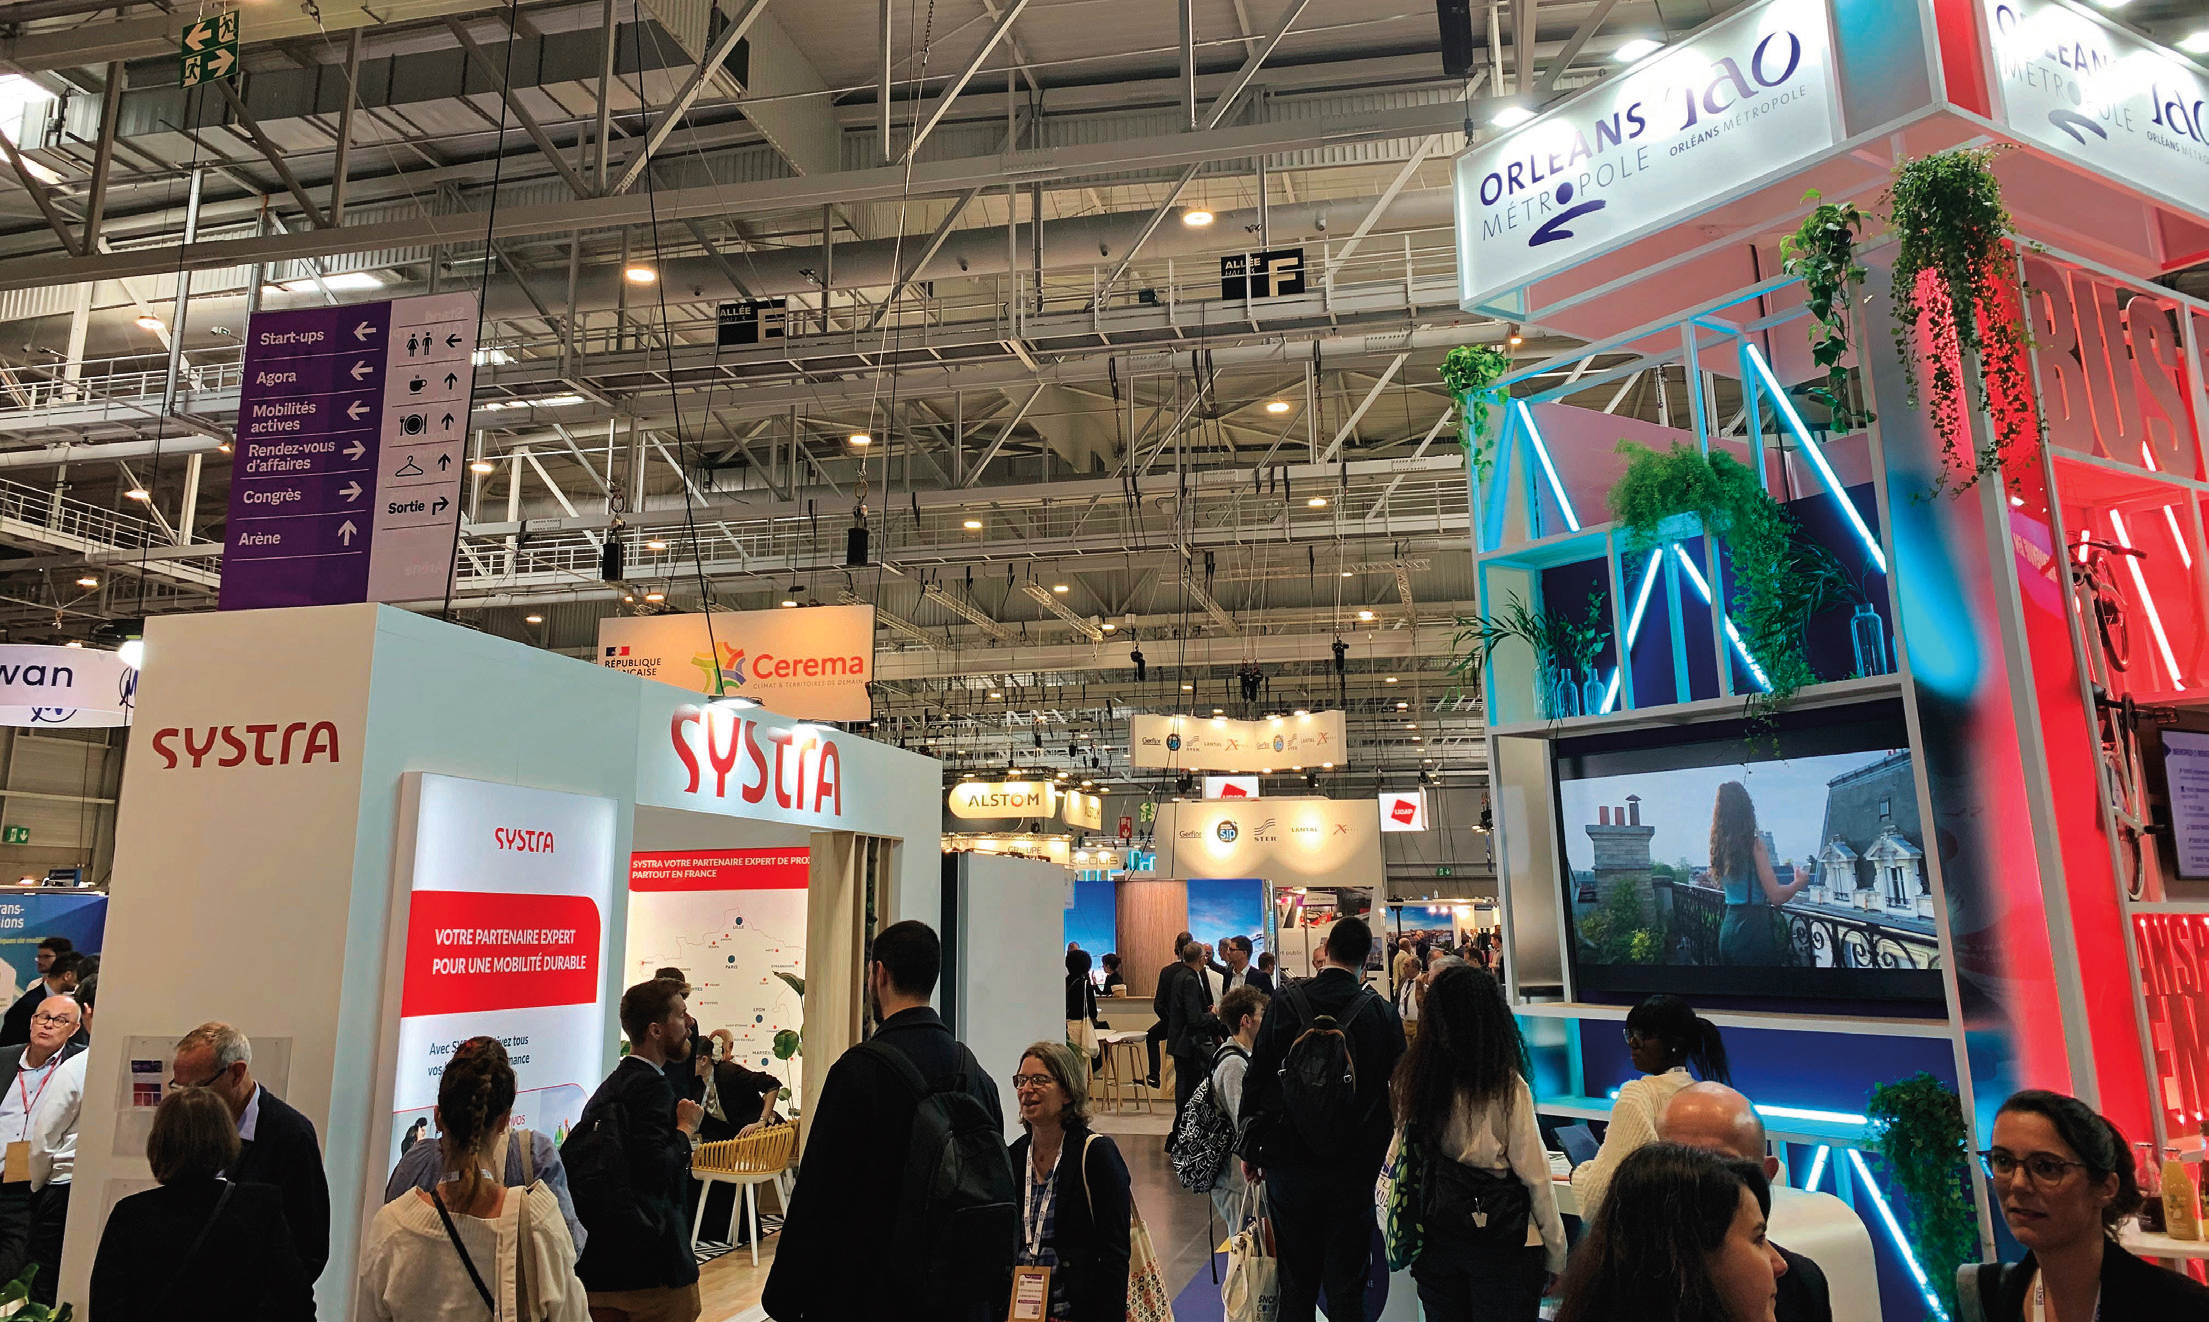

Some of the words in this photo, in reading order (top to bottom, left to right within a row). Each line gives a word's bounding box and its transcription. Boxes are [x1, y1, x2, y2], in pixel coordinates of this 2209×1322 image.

[1669, 125, 1720, 156] ORLÉANS
[1722, 84, 1807, 133] MÉTROPOLE
[1268, 257, 1299, 297] F
[720, 304, 751, 316] ALLÉE
[757, 307, 786, 345] E
[260, 330, 325, 346] Start-ups
[256, 371, 297, 388] Agora
[253, 401, 316, 418] Mobilités
[251, 419, 301, 433] actives
[248, 441, 336, 457] Rendez-vous
[246, 457, 312, 473] d'affaires
[243, 488, 301, 506] Congrès
[388, 500, 425, 514] Sortie
[238, 532, 281, 546] Arène
[605, 658, 661, 668] RÉPUBLIQUE
[752, 654, 863, 679] Cerema
[152, 721, 339, 769] SYSTRA
[671, 704, 841, 816] SYSTRA
[968, 794, 1039, 807] ALSTOM
[495, 827, 554, 853] SYSTRA
[1008, 846, 1042, 854] GROUPE
[632, 860, 663, 869] SYSTRA
[664, 859, 691, 867] VOTRE
[692, 858, 744, 867] PARTENAIRE
[745, 857, 777, 866] EXPERT
[777, 857, 789, 865] DE
[632, 870, 671, 879] PARTOUT
[671, 869, 684, 878] EN
[684, 869, 717, 878] FRANCE
[435, 929, 474, 945] VOTRE
[475, 929, 539, 945] PARTENAIRE
[541, 929, 576, 945] EXPERT
[432, 957, 466, 975] POUR
[468, 957, 491, 974] UNE
[493, 952, 542, 973] MOBILITÉ
[543, 955, 587, 971] DURABLE
[429, 1042, 450, 1056] Avec
[513, 1034, 529, 1046] tous
[427, 1066, 442, 1076] vos
